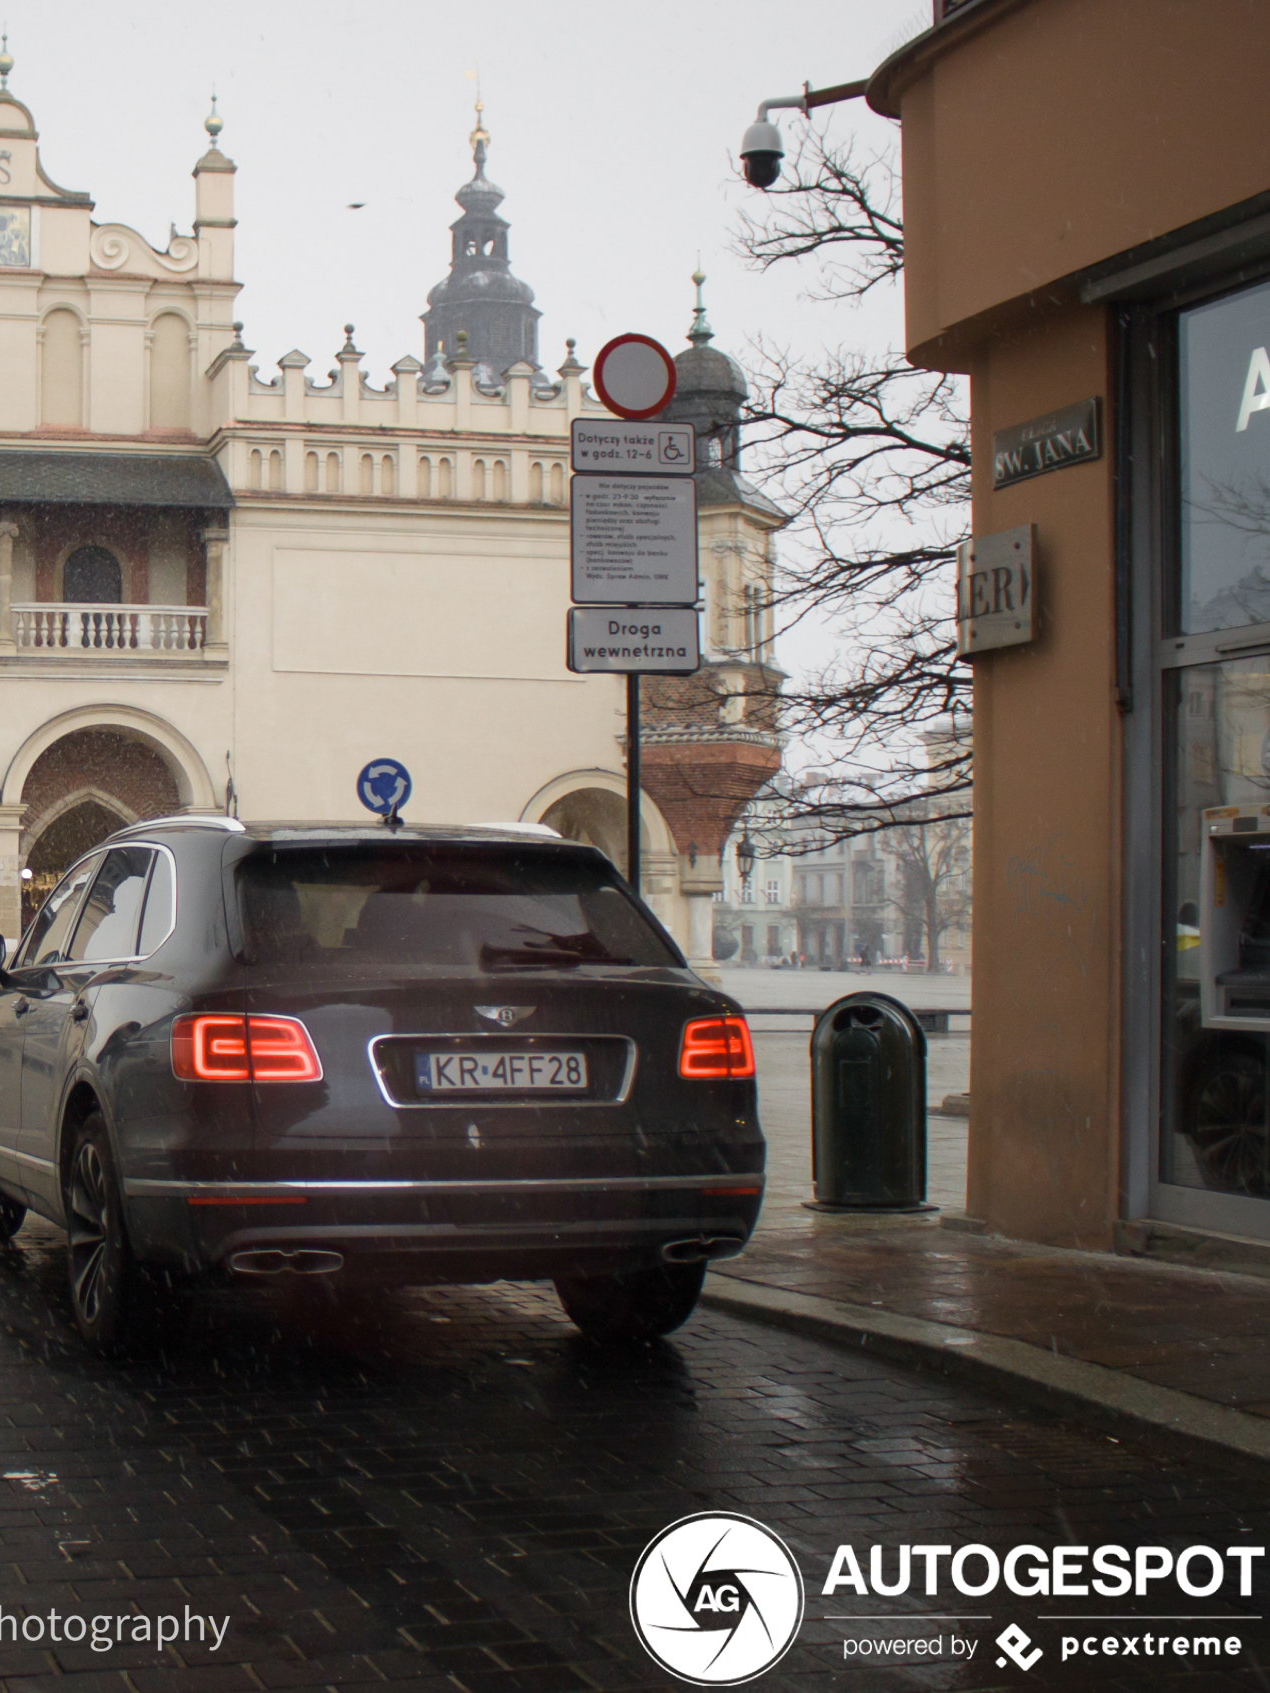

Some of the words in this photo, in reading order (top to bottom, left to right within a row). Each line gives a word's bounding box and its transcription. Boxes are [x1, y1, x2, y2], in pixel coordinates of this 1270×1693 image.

[578, 432, 620, 446] Dotyczy
[624, 435, 655, 445] także
[592, 449, 623, 460] godz.
[626, 449, 652, 459] 12-6
[1034, 428, 1092, 470] JANA
[608, 620, 662, 639] Droga
[419, 1075, 431, 1085] PL
[435, 1056, 480, 1087] KR
[491, 1055, 582, 1087] 4FF28
